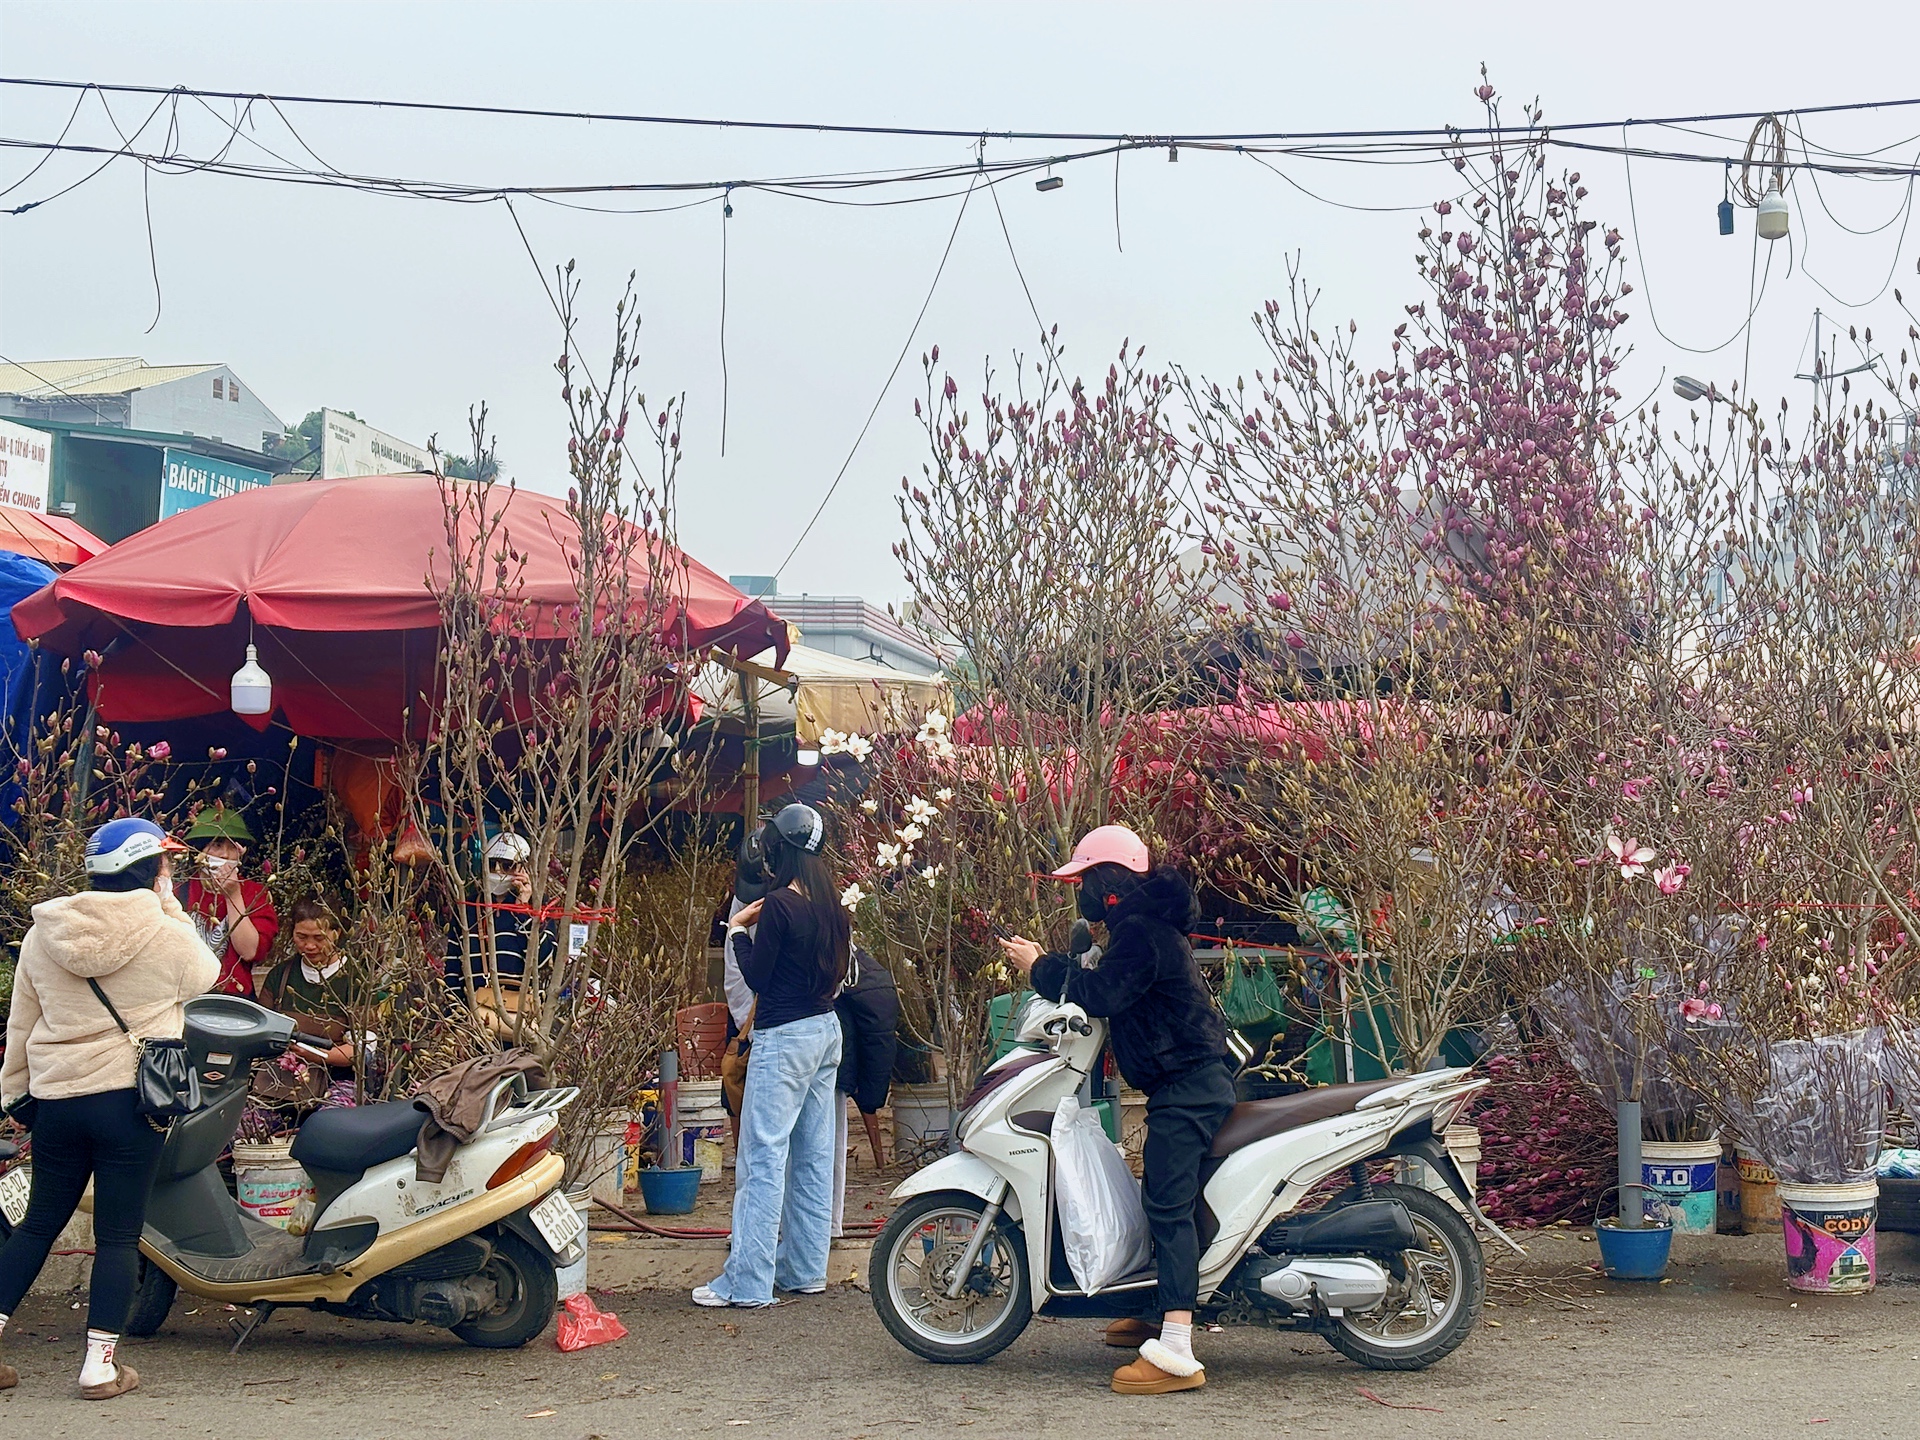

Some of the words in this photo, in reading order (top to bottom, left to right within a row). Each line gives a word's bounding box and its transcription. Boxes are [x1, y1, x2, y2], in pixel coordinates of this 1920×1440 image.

[168, 460, 208, 495] BÁCH
[209, 472, 236, 499] LAN
[12, 490, 41, 511] CHUNG
[1008, 1147, 1039, 1156] HONDA
[415, 1194, 461, 1217] SPACY
[536, 1195, 568, 1229] 29-X2
[549, 1213, 580, 1247] 3000
[1824, 1216, 1870, 1233] CODY
